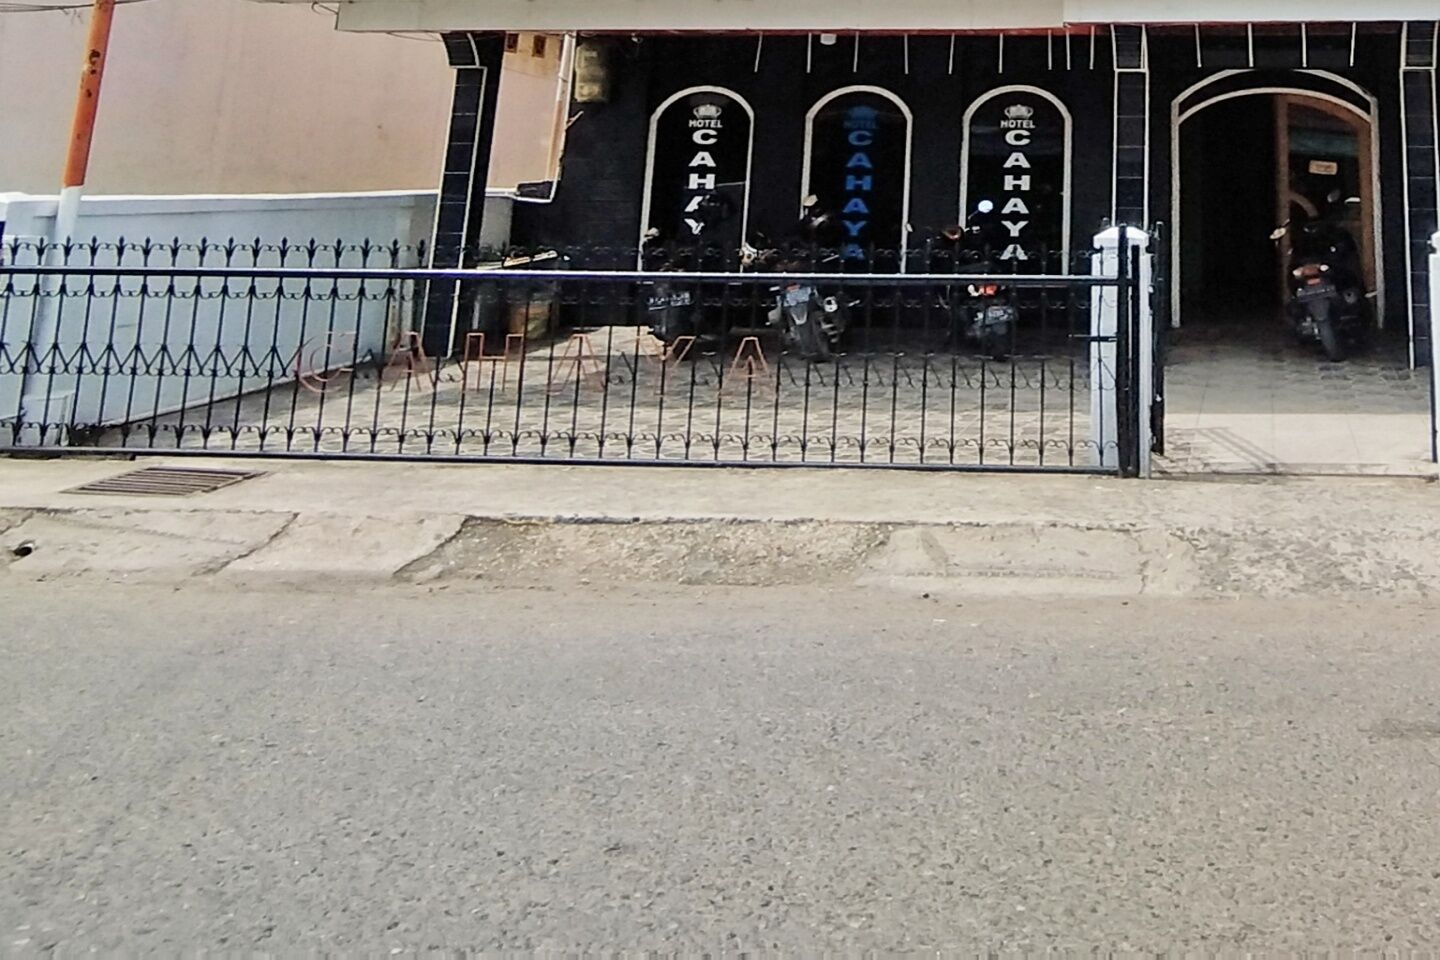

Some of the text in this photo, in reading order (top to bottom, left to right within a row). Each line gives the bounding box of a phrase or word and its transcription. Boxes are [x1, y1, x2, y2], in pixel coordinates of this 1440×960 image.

[688, 119, 723, 129] HOTEL
[1000, 119, 1036, 129] HOTEL
[840, 130, 873, 260] CAHAYA
[1000, 129, 1030, 261] CAHAYA
